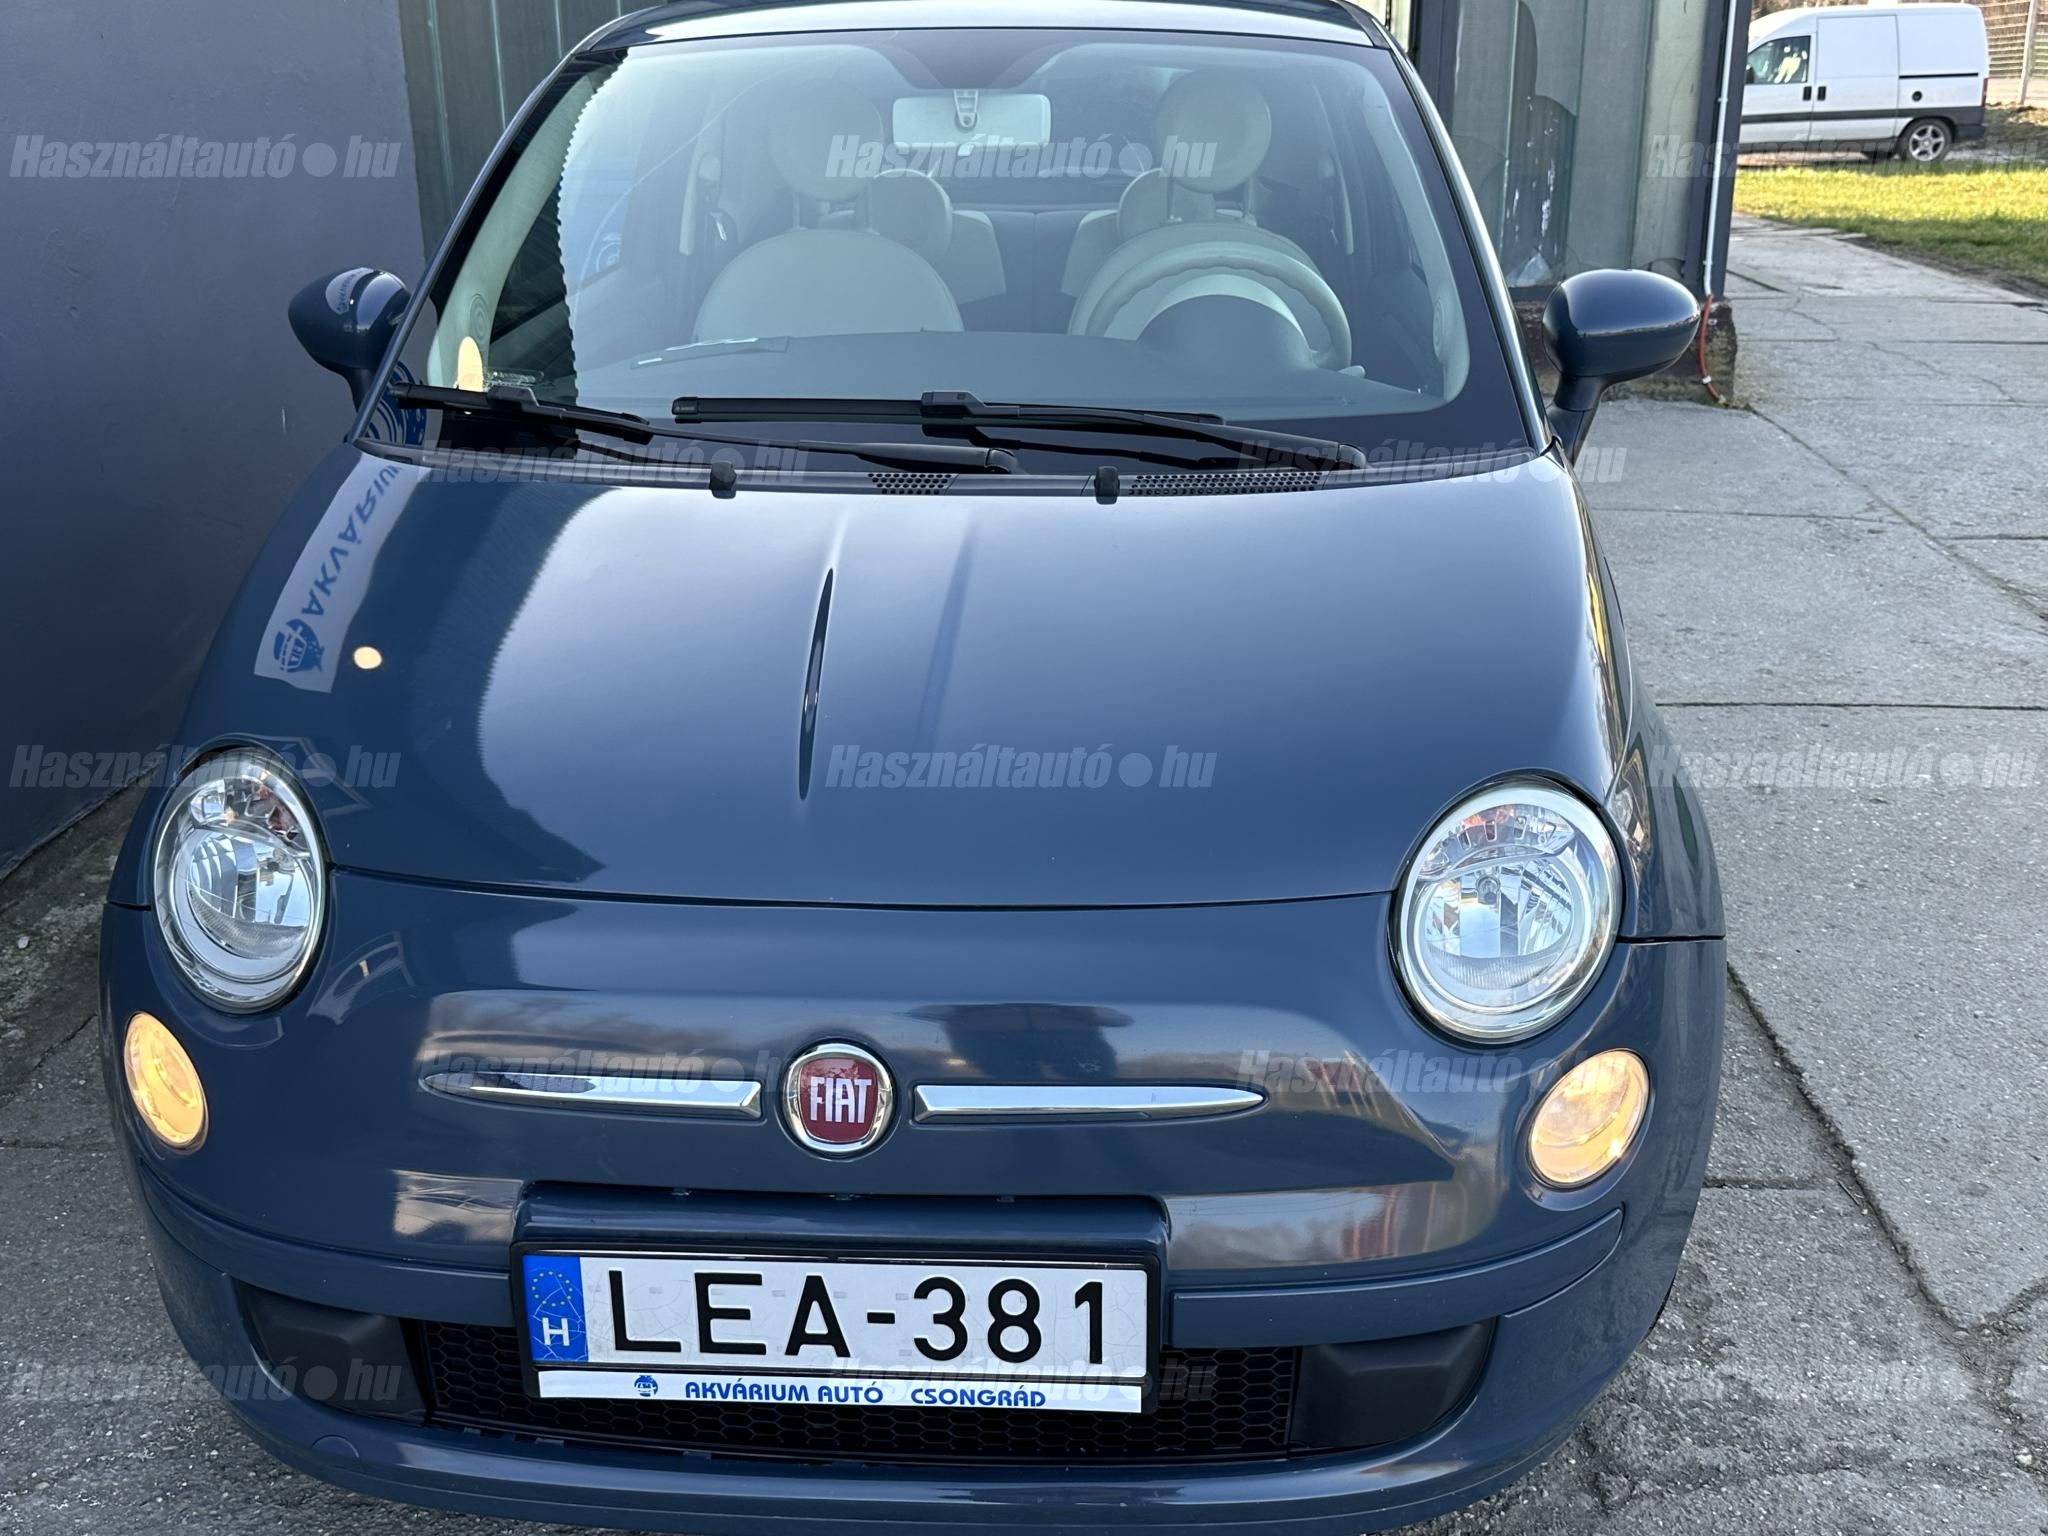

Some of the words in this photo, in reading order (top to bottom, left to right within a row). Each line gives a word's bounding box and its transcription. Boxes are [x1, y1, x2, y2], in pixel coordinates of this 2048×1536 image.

[810, 1076, 873, 1123] FIAT
[542, 1317, 570, 1346] H
[608, 1269, 1103, 1364] LEA-381
[685, 1378, 810, 1402] AKVÁRIUM
[817, 1381, 884, 1403] AUTÓ
[910, 1385, 1046, 1407] CSONGRÁD
